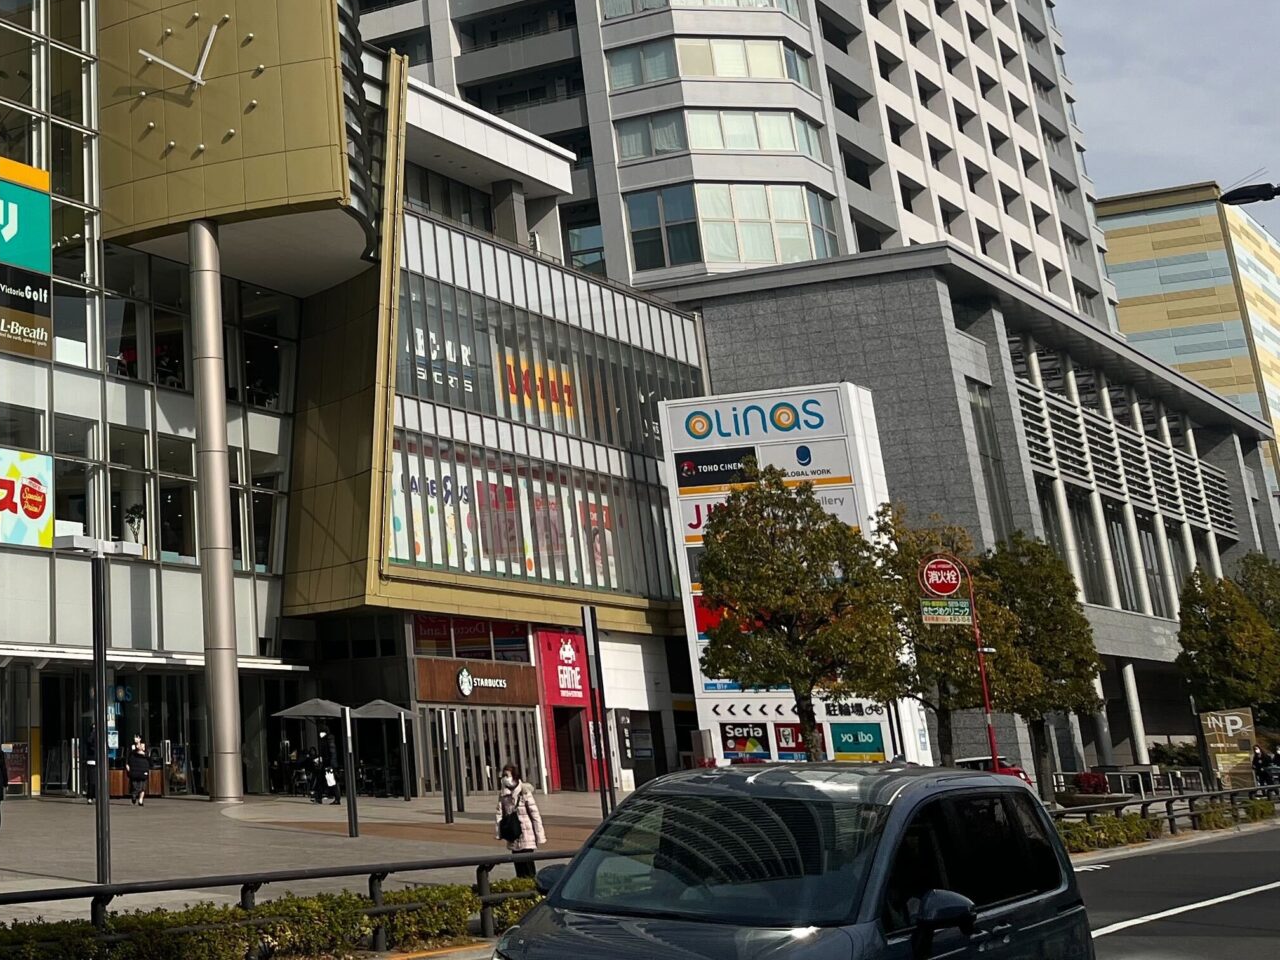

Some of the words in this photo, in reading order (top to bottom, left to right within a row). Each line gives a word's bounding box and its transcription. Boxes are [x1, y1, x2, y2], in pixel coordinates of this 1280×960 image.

[698, 464, 719, 473] TOHO
[720, 461, 744, 472] CINEM
[810, 468, 832, 477] WORK
[927, 570, 958, 584] 消火栓
[473, 676, 508, 689] STARBUCKS
[825, 703, 864, 717] 駐輪場
[724, 724, 763, 738] Seria
[1207, 716, 1224, 729] IN
[1224, 715, 1243, 737] P
